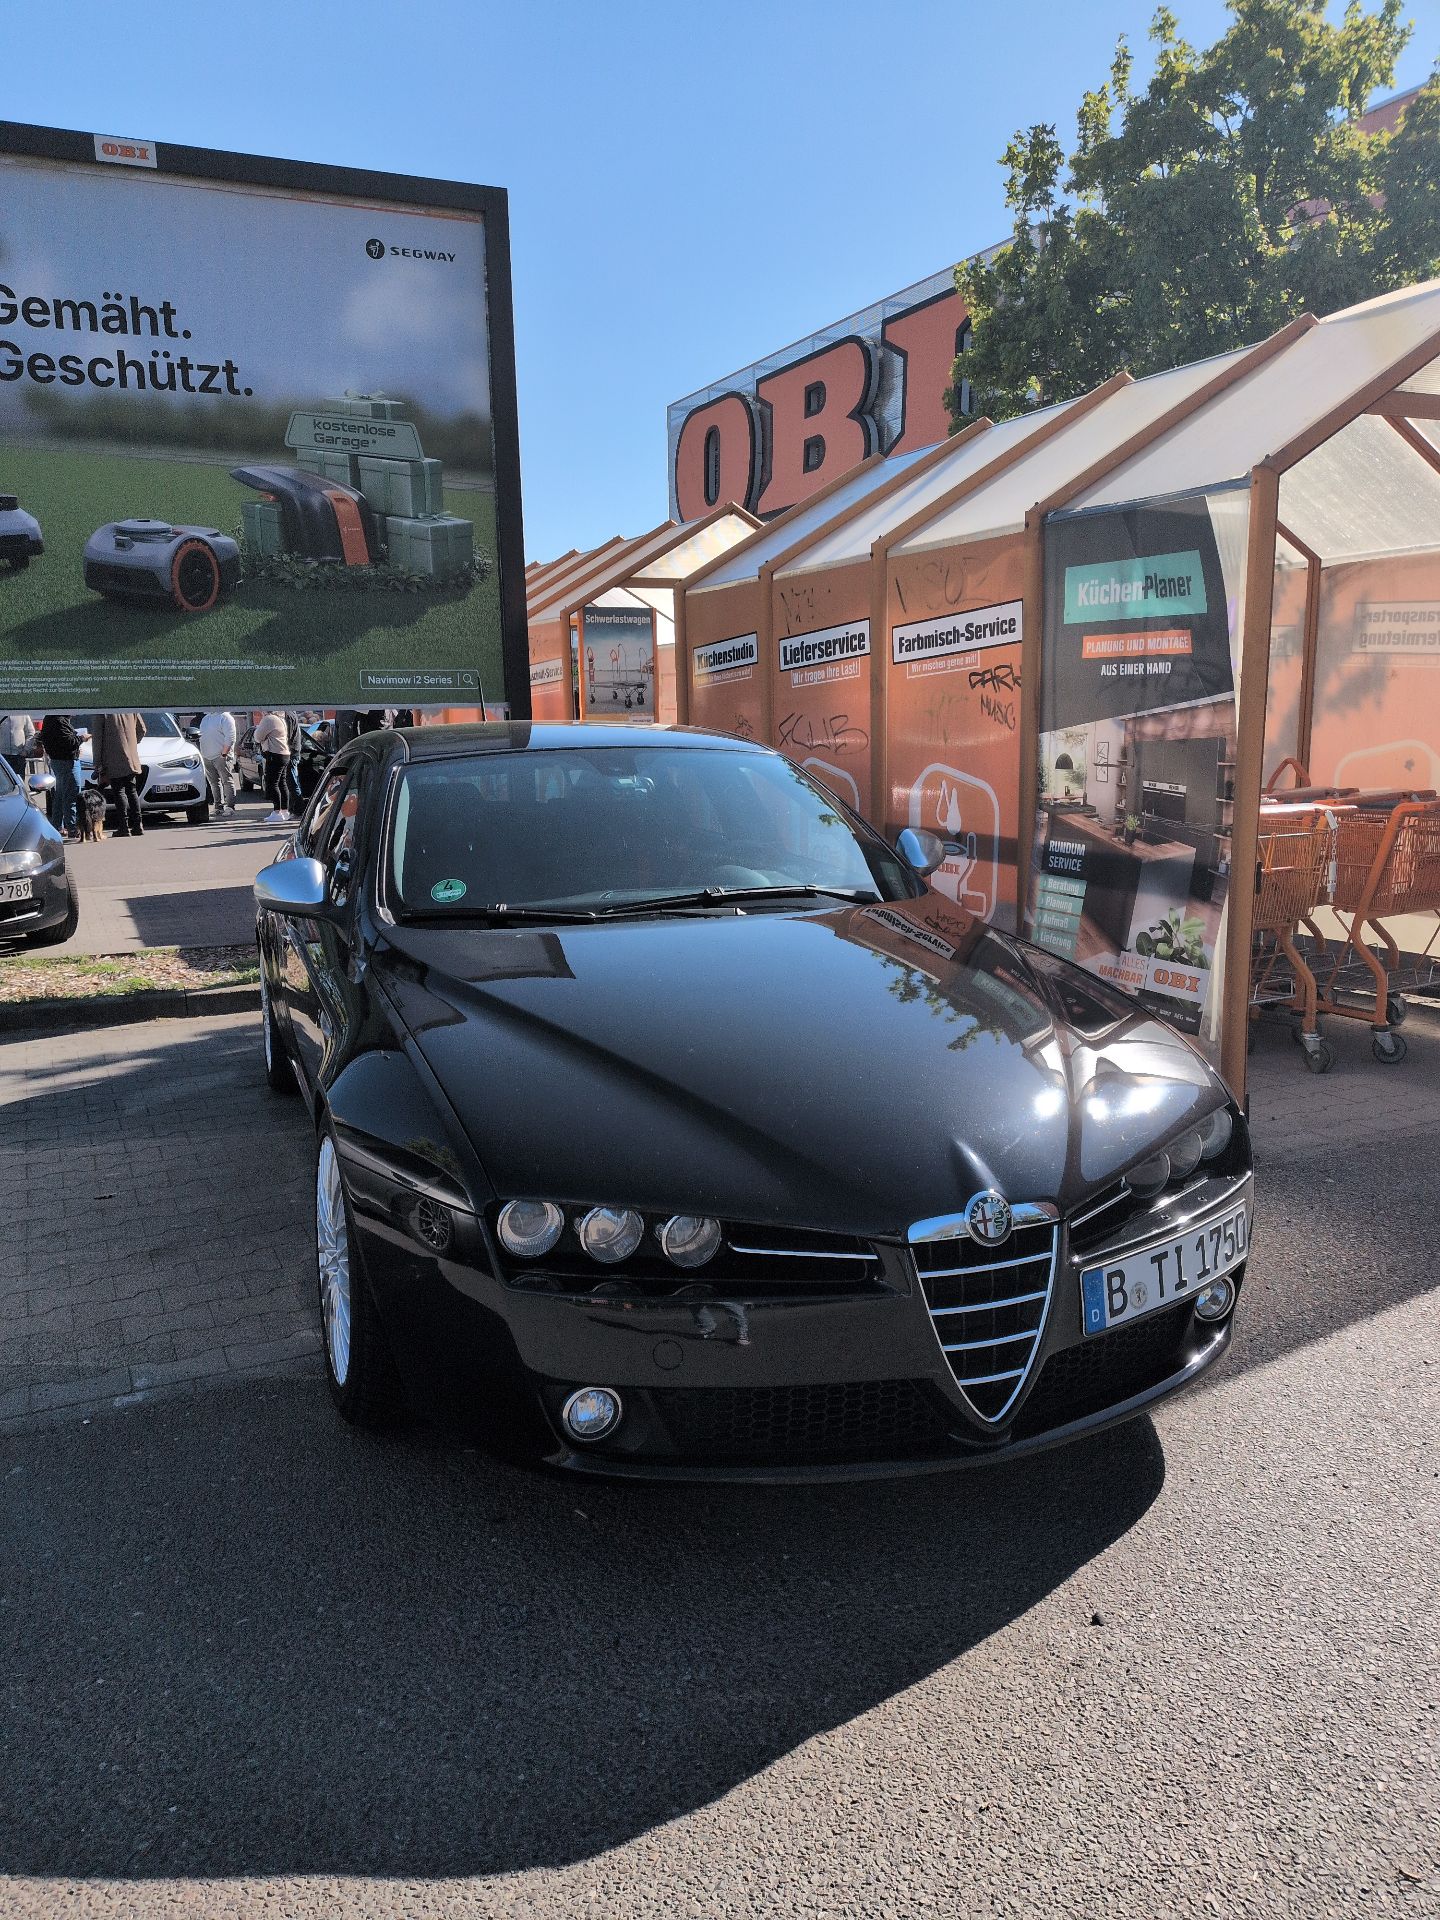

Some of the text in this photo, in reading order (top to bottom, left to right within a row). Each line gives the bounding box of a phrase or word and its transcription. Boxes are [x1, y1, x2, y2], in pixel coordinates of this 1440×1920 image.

[102, 143, 149, 160] OBI
[390, 247, 456, 262] SEGWAY
[0, 284, 192, 339] Gemäht.
[0, 340, 253, 397] Geschützt.
[675, 287, 973, 523] OBI
[313, 419, 396, 437] kostenlose
[585, 614, 651, 626] Schwerlastwagen
[898, 617, 1017, 654] Farbmisch-Service
[783, 632, 866, 666] Lieferservice
[1086, 636, 1189, 653] PLANUNG UND MONTAGE
[697, 643, 754, 670] Küchenstudio
[792, 661, 858, 684] Wir tragen Ihre Last!
[911, 662, 921, 673] Wir
[922, 660, 945, 671] mischen
[1100, 662, 1172, 676] AUS EINER HAND
[368, 675, 453, 685] Navimow i2 Series
[1048, 840, 1086, 856] RUNDUM
[1048, 855, 1082, 872] SERVICE
[7, 882, 30, 898] 789
[443, 880, 453, 890] 4
[1048, 878, 1079, 895] Beratung
[1045, 896, 1073, 912] Planung
[1042, 913, 1069, 929] Aufmaß
[1040, 931, 1072, 950] Lieferung
[1121, 956, 1146, 970] ALLES
[1098, 964, 1143, 984] MACHBAR
[1153, 968, 1201, 993] OBI
[1106, 1210, 1247, 1318] B TI 1750
[1091, 1308, 1100, 1323] D
